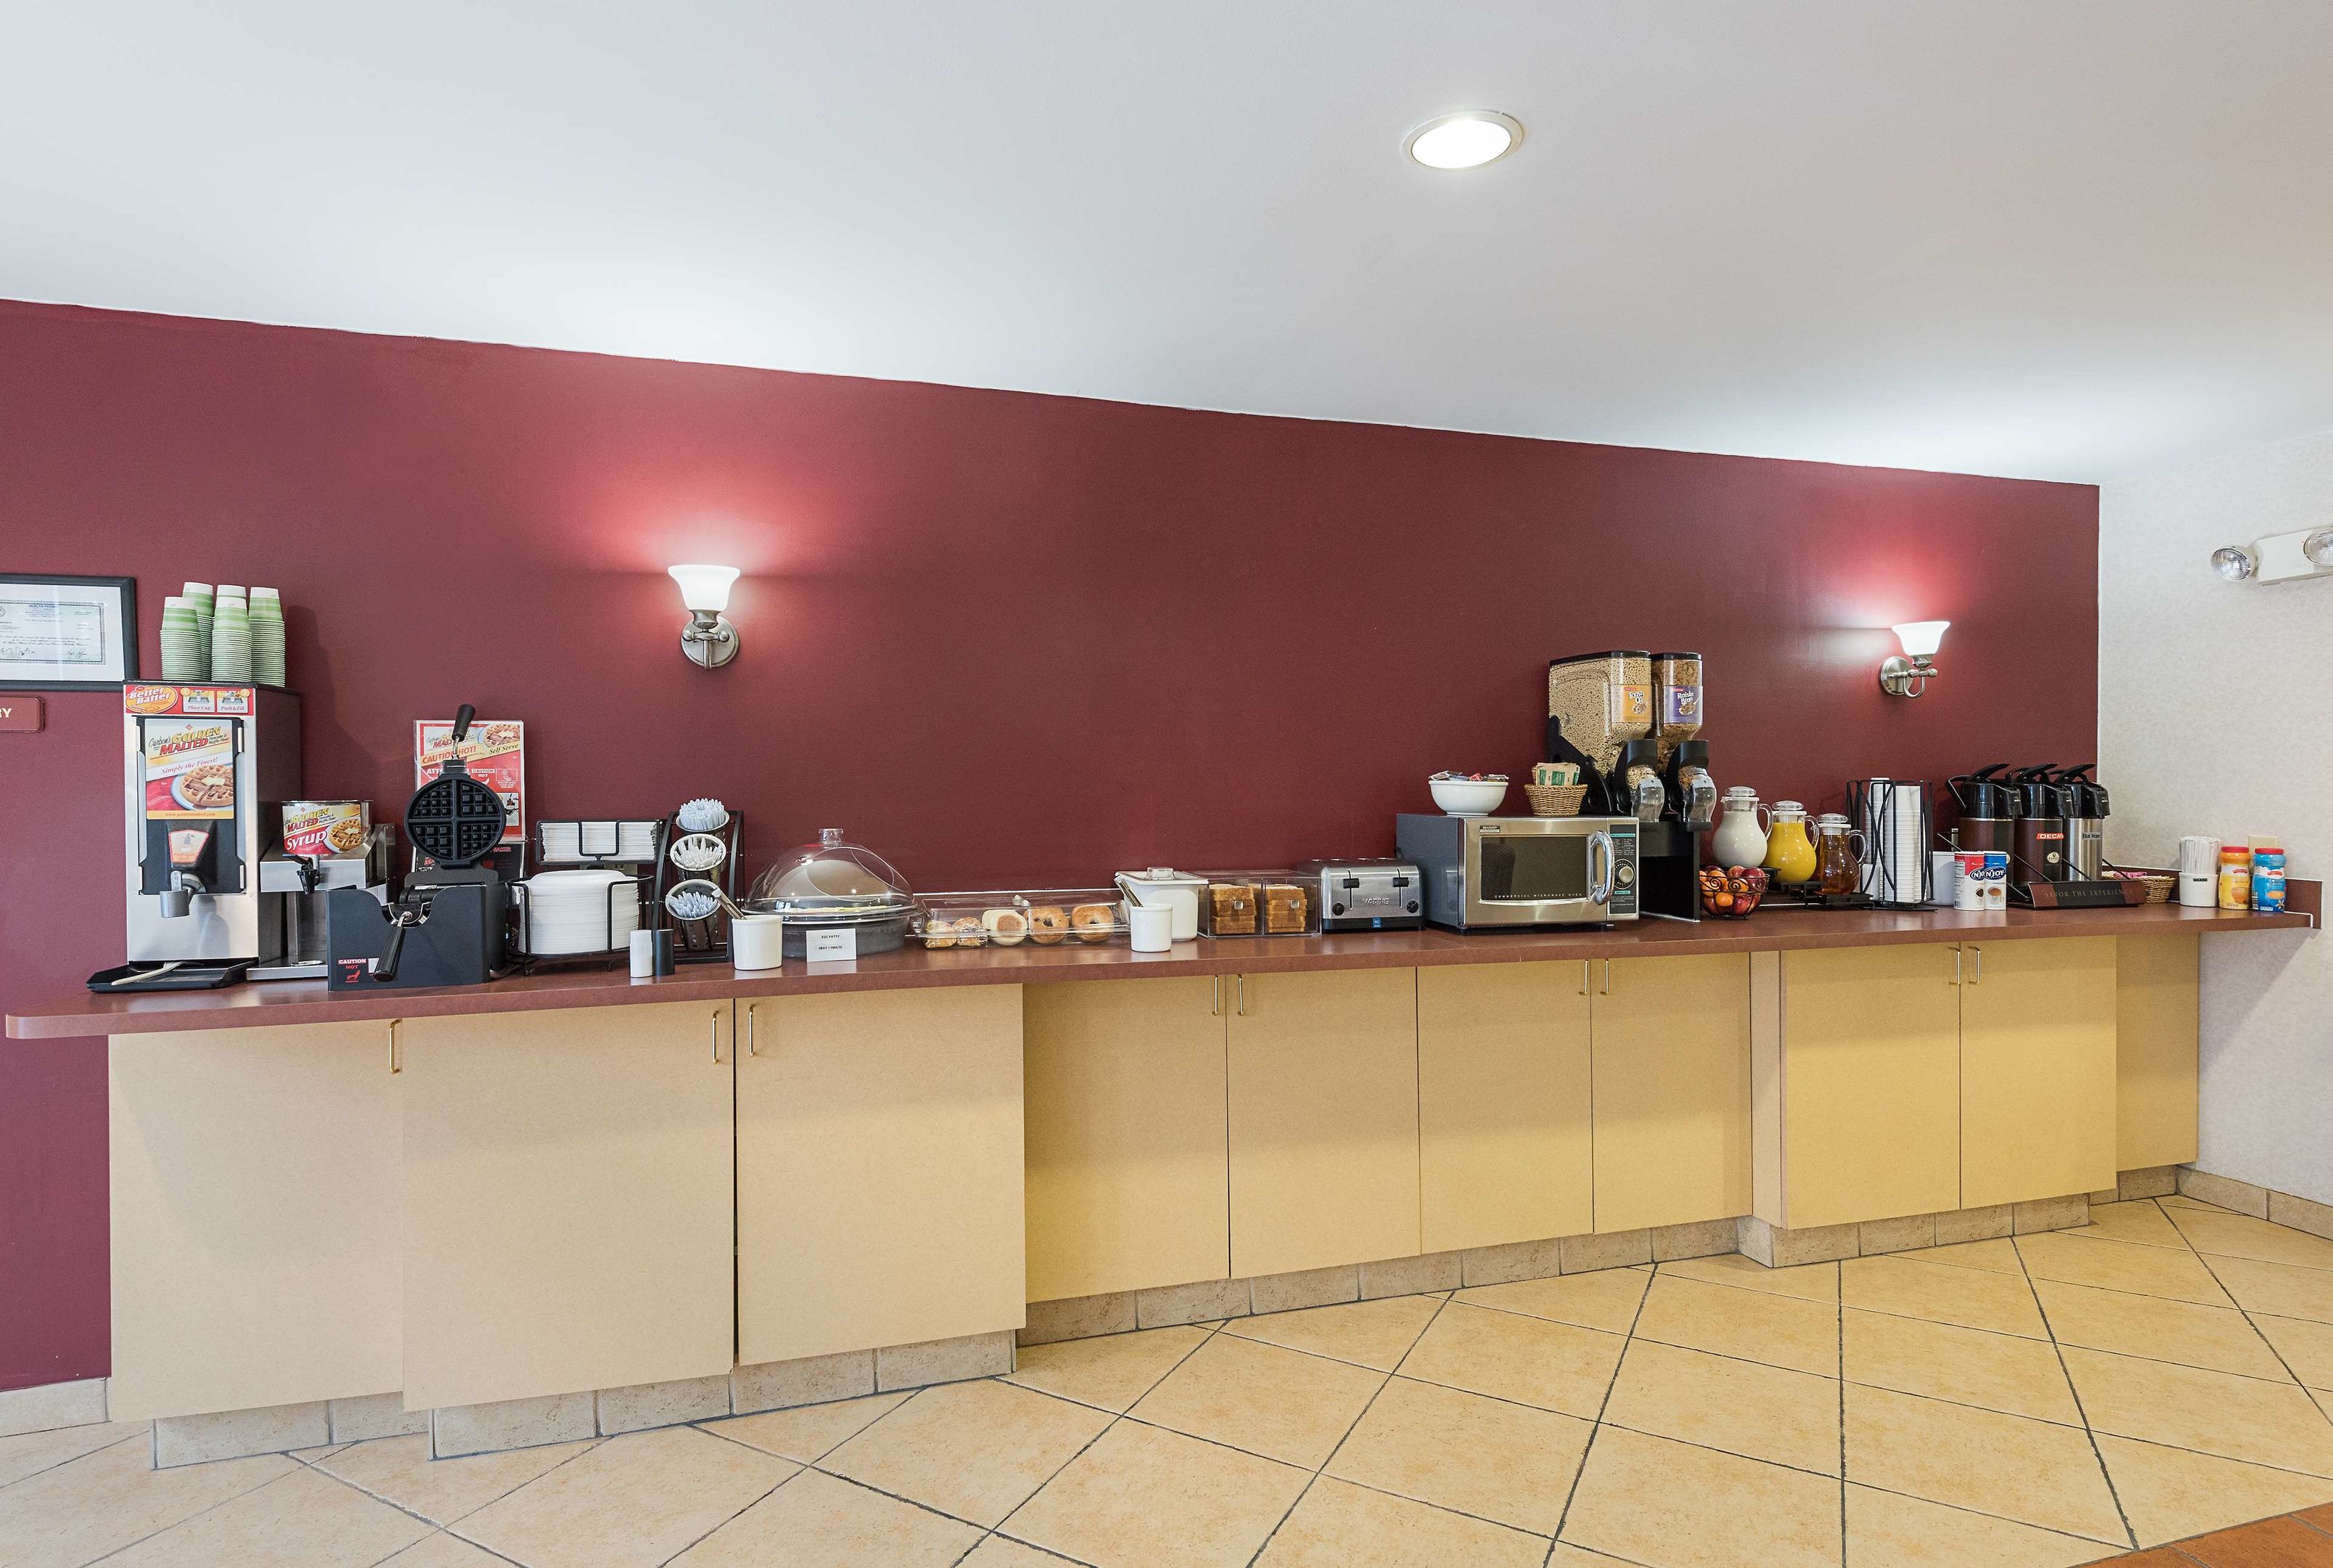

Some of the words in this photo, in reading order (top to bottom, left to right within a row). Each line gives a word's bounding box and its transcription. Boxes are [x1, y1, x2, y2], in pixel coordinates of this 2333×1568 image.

[129, 687, 165, 700] Better
[136, 692, 171, 705] Batter
[1677, 691, 1694, 700] Raisin
[1680, 696, 1693, 705] Bran
[171, 726, 221, 745] GOLDEN
[160, 738, 209, 755] MALTED
[458, 746, 476, 756] HOT!
[489, 746, 502, 755] Self
[197, 756, 218, 767] Finest!
[286, 817, 319, 833] MALTED
[286, 830, 327, 851] Syrup
